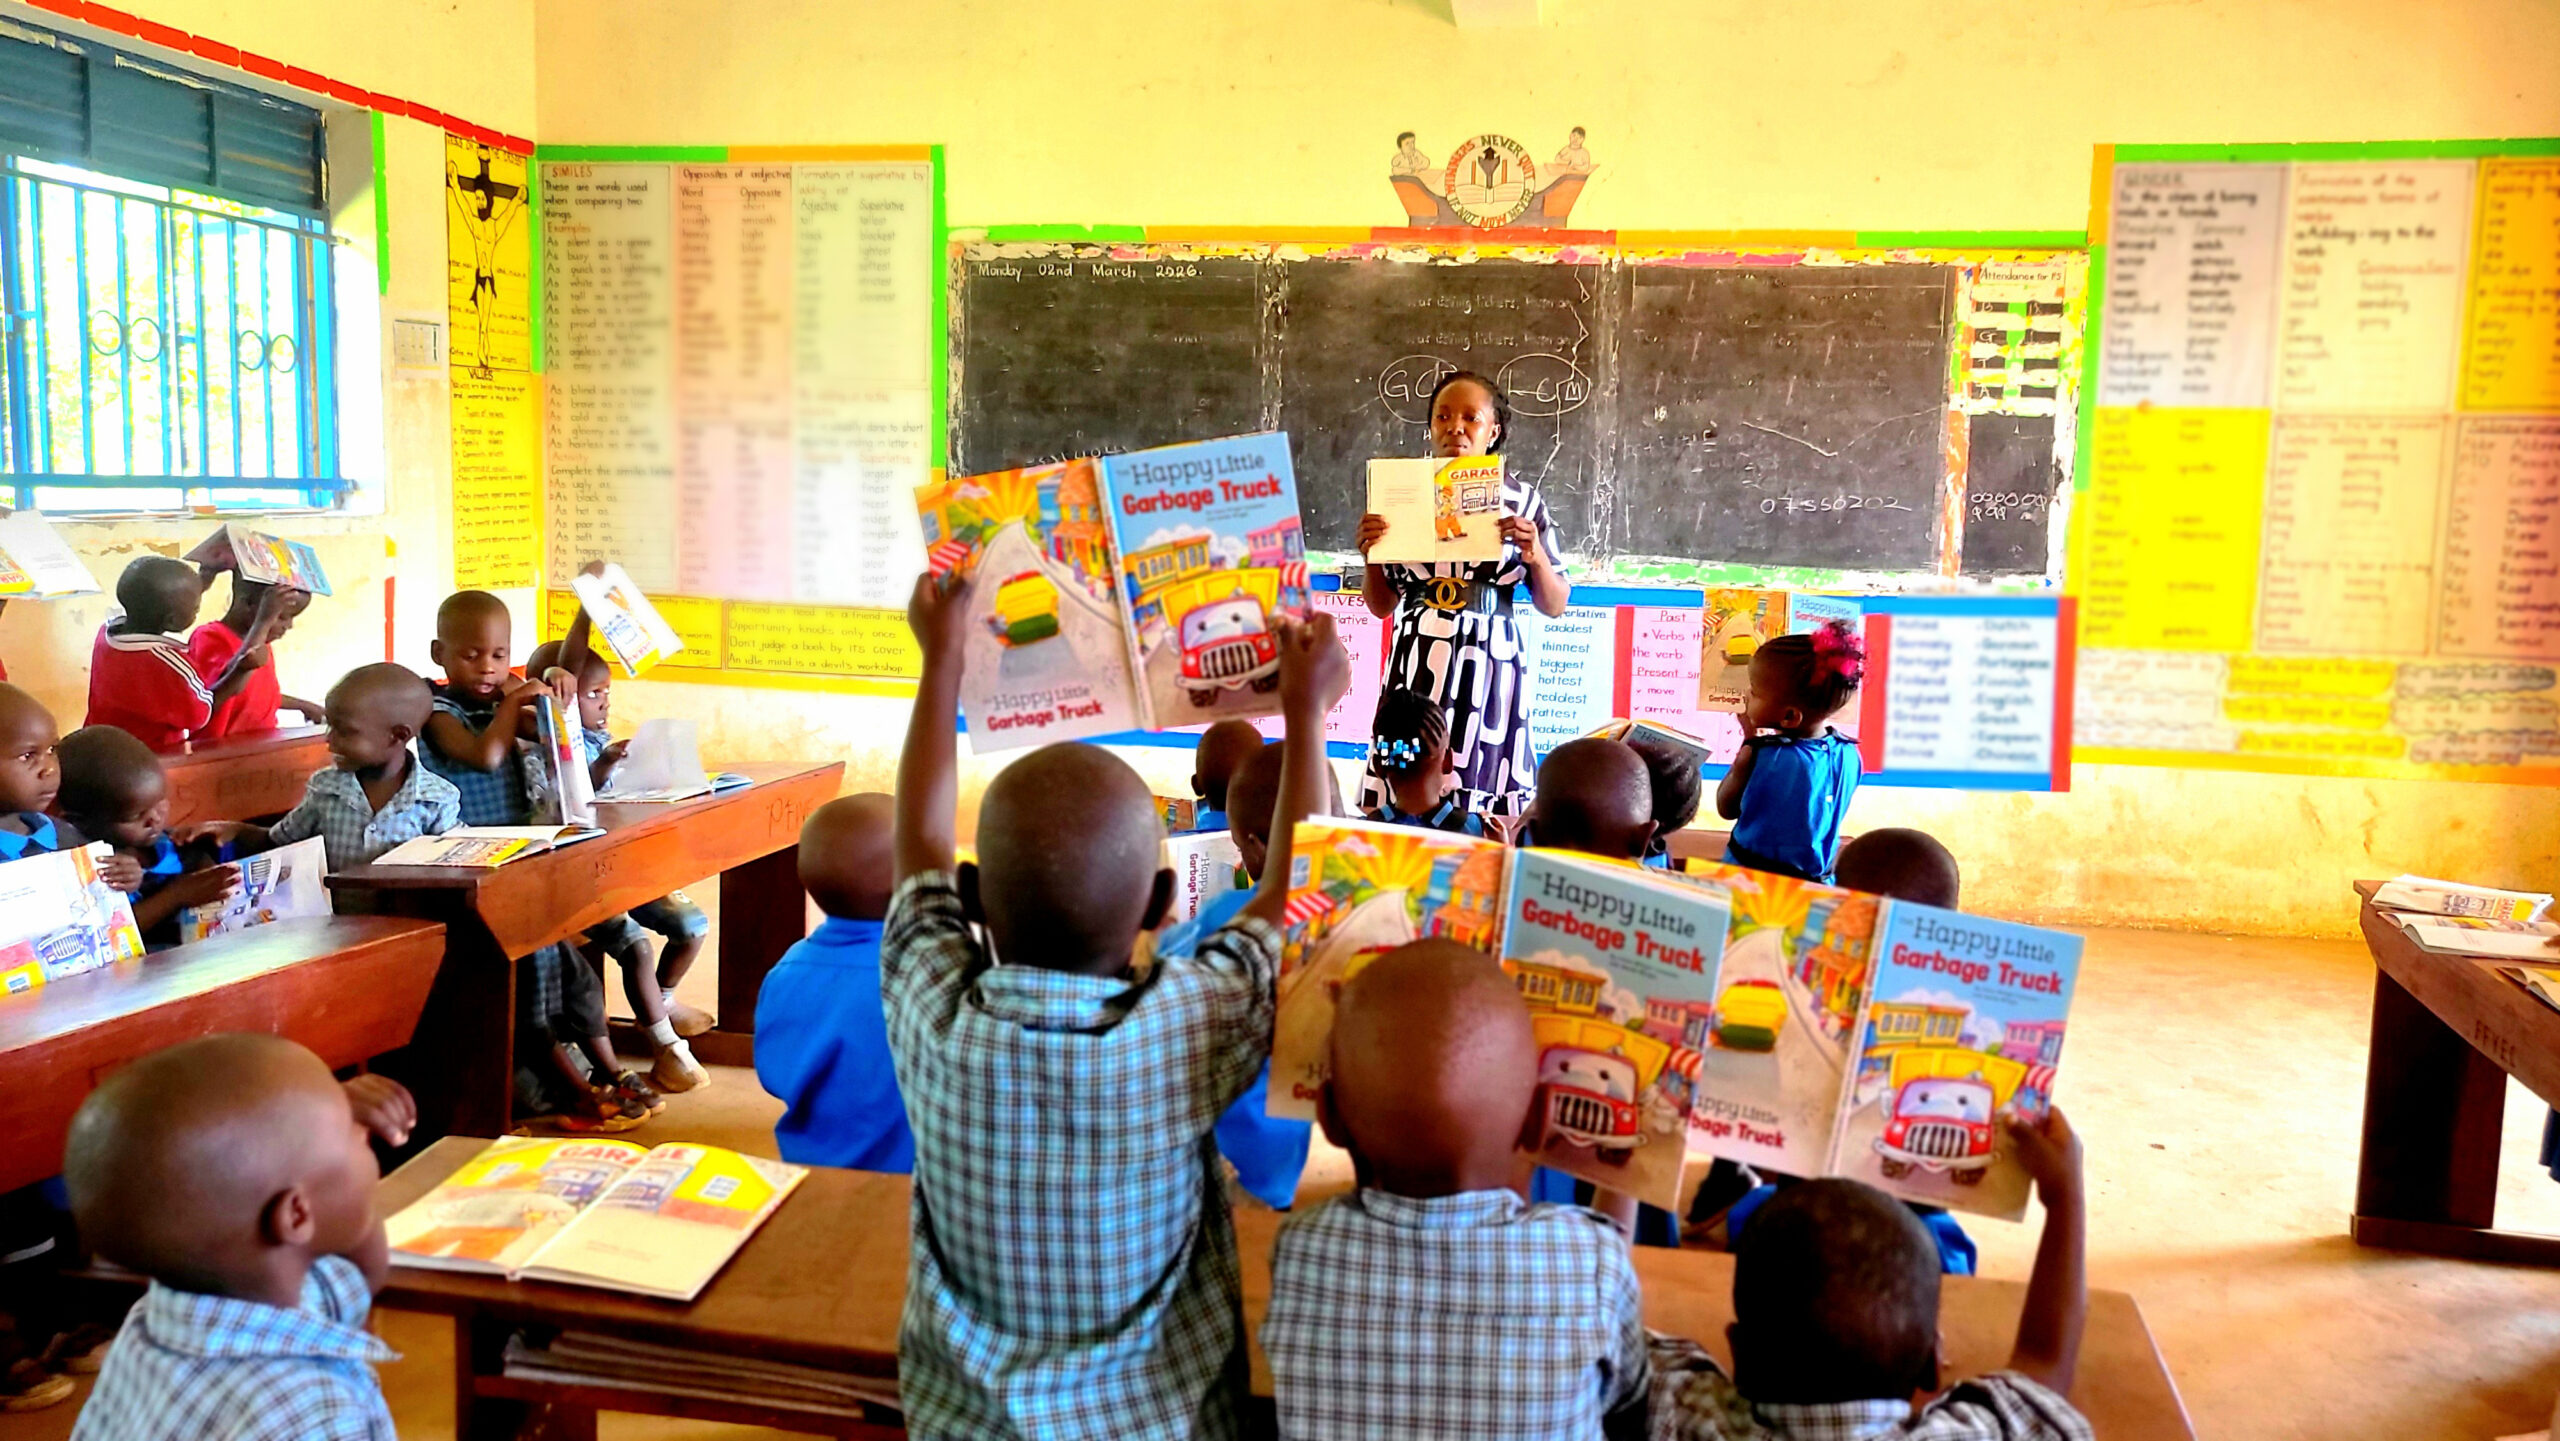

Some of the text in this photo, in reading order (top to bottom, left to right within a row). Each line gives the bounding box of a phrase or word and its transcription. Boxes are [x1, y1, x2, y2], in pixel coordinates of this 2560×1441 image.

[1481, 135, 1535, 180] NEVER QUIT
[552, 166, 593, 178] SIMILES
[544, 180, 648, 191] These are words used
[680, 188, 782, 200] Word Opposite
[544, 195, 643, 208] when comparing two
[1457, 207, 1479, 223] NOT
[1479, 213, 1507, 228] NOW
[1508, 188, 1534, 219] NEVER
[567, 248, 589, 263] busy
[978, 264, 1022, 282] Monday
[1038, 264, 1074, 277] 02nd
[1091, 263, 1136, 278] March
[1980, 267, 2034, 281] Attendance
[2037, 272, 2048, 281] for
[1133, 454, 1265, 487] Happy Little
[1450, 468, 1500, 480] GARAG
[1122, 484, 1214, 515] Garbage
[1218, 475, 1282, 501] Truck
[575, 545, 604, 558] happy
[1315, 595, 1365, 607] CTIVES
[793, 607, 815, 617] need
[852, 610, 881, 621] friend
[1337, 613, 1368, 625] lative
[1560, 608, 1607, 620] erlative
[1660, 610, 1686, 622] Past
[729, 620, 896, 639] Opportunity knocks only once
[1544, 623, 1592, 634] saddest
[1651, 628, 1685, 641] Verbs
[759, 639, 786, 652] judge
[802, 642, 825, 651] book
[830, 644, 842, 655] by
[873, 647, 905, 655] cover
[1541, 641, 1590, 654] thinnest
[1632, 646, 1683, 660] the verb
[729, 653, 741, 664] An
[745, 655, 763, 665] idle
[768, 657, 792, 667] mind
[795, 659, 804, 667] is
[857, 663, 903, 673] workshop
[1539, 658, 1584, 673] biggest
[1637, 666, 1679, 677] Present
[1537, 673, 1582, 687] hottest
[1647, 687, 1675, 695] move
[993, 685, 1090, 712] Happy Little
[1535, 692, 1587, 705] reddest
[1708, 694, 1740, 704] Garbage
[986, 700, 1104, 731] Garbage Truck
[1644, 706, 1682, 714] arrive
[1188, 853, 1198, 893] Garbage
[1199, 857, 1211, 894] Happy
[1543, 871, 1697, 938] Happy Little
[1522, 898, 1625, 952] Garbage
[1634, 930, 1707, 977] Truck
[1914, 916, 2055, 964] Happy Little
[1892, 944, 1989, 982] Garbage
[1998, 963, 2064, 996] Truck
[1742, 1105, 1780, 1125] Little
[1692, 1113, 1786, 1149] bage Truck
